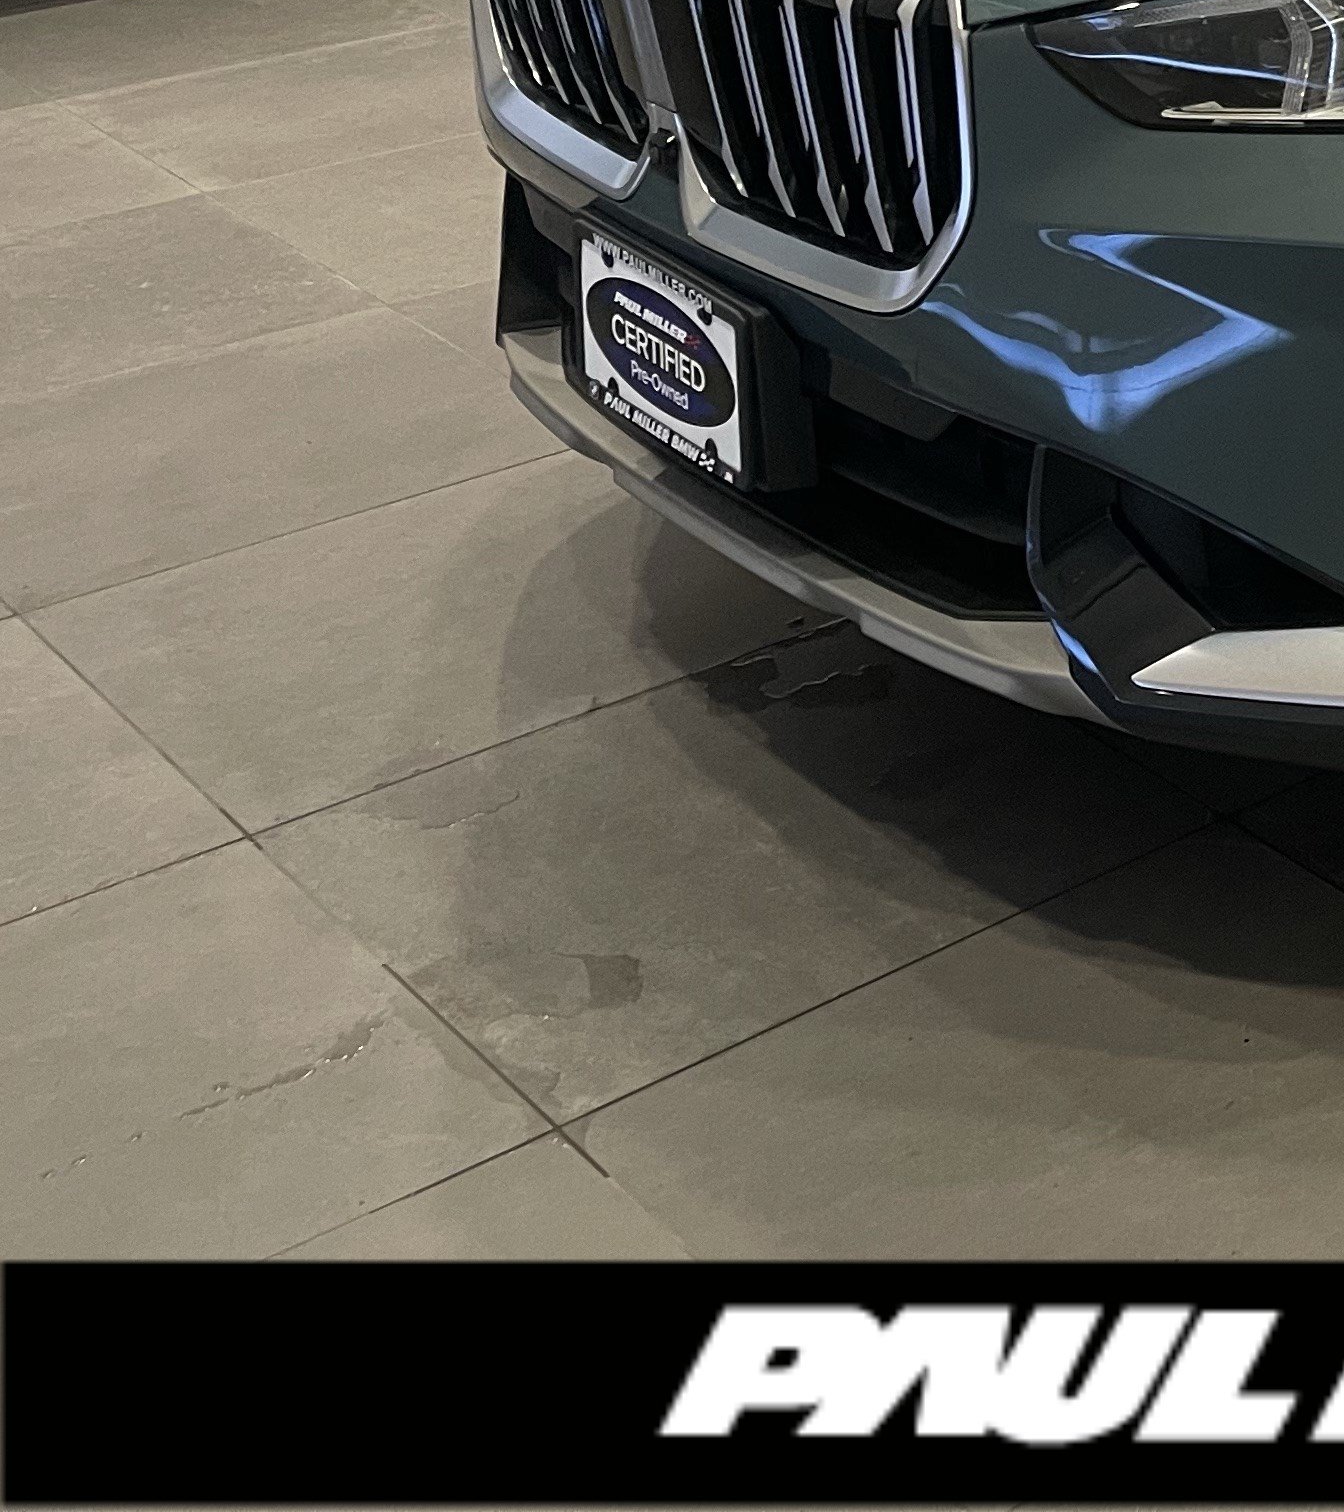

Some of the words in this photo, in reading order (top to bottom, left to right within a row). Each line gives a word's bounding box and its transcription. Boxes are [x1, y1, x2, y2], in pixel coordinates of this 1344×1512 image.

[613, 291, 642, 317] PAUL
[642, 308, 687, 344] MILLER
[611, 313, 706, 392] CERTIFIED
[630, 360, 689, 410] Pre-Owned
[603, 391, 631, 419] PAUL
[631, 409, 670, 444] MILLER
[671, 434, 700, 462] BMW
